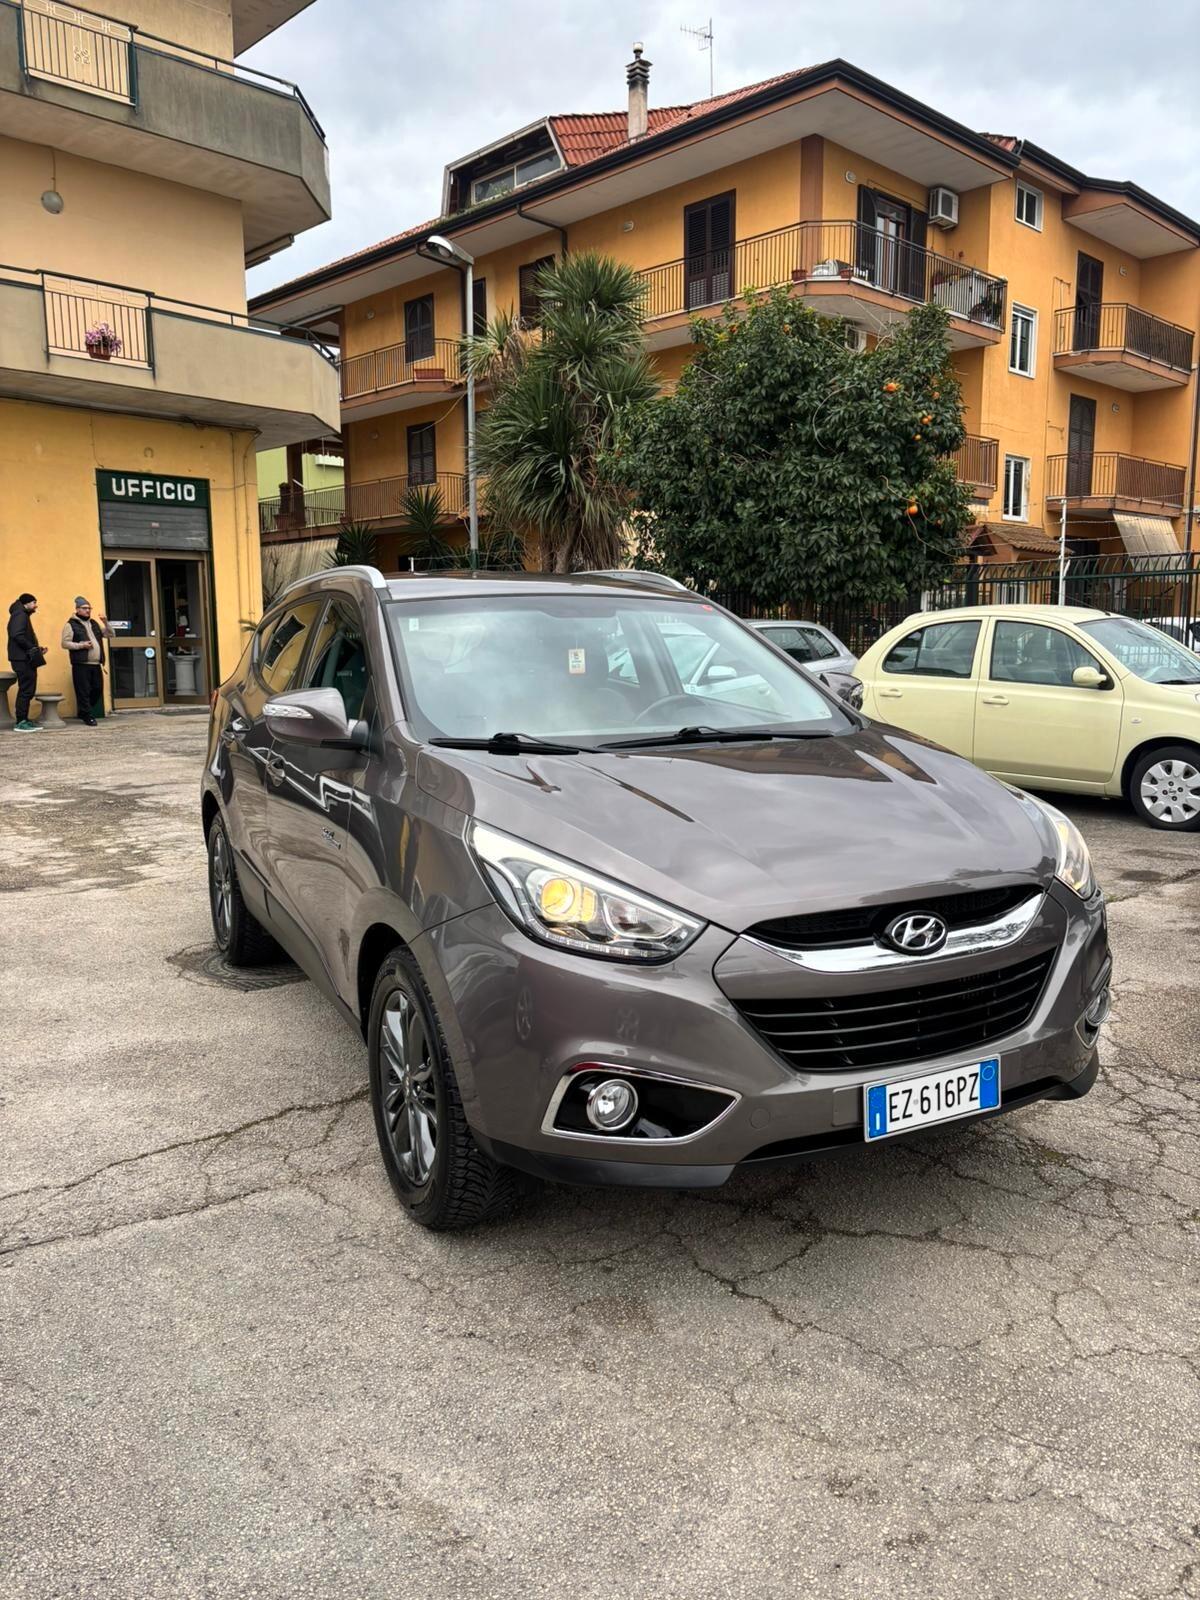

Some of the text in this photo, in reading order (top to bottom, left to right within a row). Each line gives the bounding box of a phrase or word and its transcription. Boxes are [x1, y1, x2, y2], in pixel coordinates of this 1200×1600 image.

[111, 477, 196, 502] UFFICIO
[889, 1072, 980, 1123] EZ 616PZ
